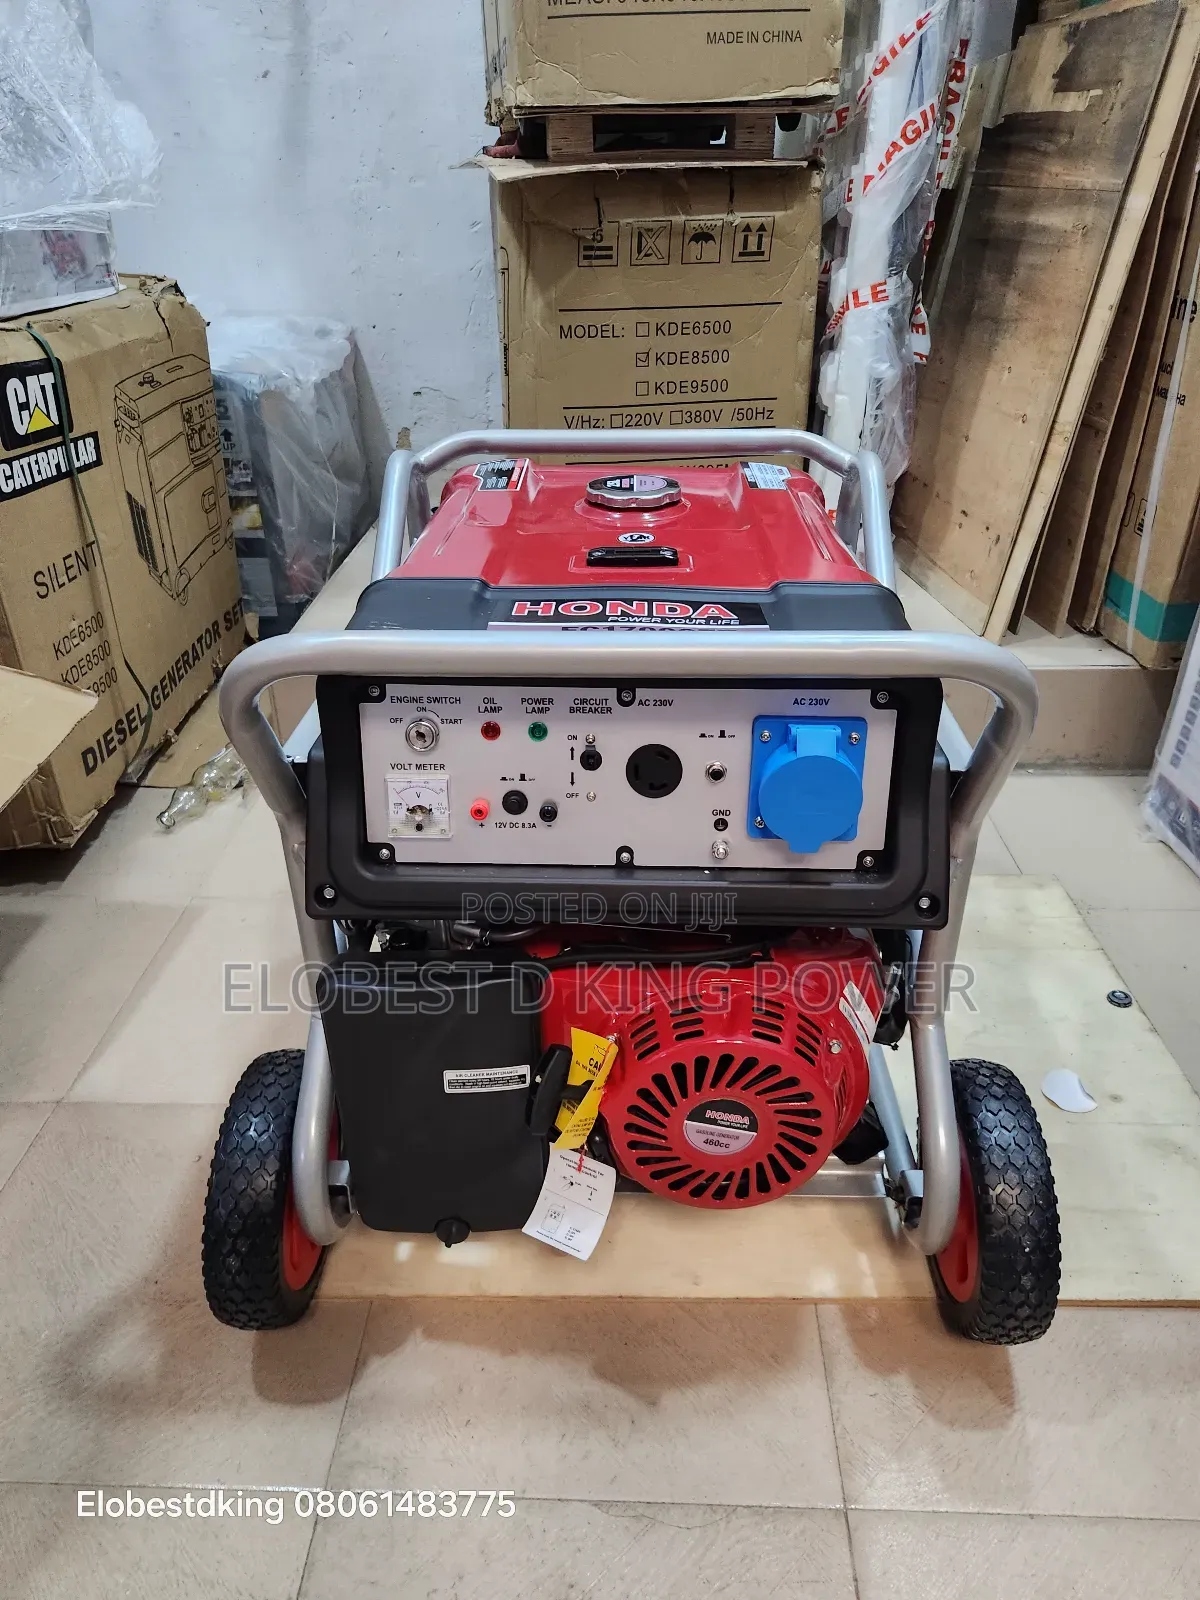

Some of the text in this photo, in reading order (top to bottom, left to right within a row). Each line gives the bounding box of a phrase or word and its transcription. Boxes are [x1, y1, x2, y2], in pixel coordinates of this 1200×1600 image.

[706, 30, 803, 45] MADE IN CHINA
[559, 320, 732, 340] MODEL: KDE6500
[655, 350, 730, 366] KDE8500
[654, 379, 729, 395] KDE9500
[6, 372, 59, 436] CAT
[564, 407, 774, 429] V/Hz: 220V 380V /50Hz
[222, 443, 236, 451] UP
[33, 541, 100, 600] SILENT
[511, 600, 738, 618] HONDA
[53, 611, 104, 660] KDE6500
[61, 640, 110, 685] KDE8500
[81, 598, 244, 777] DIESEL GENERATOR SET
[390, 696, 461, 705] ENGINE SWITCH
[482, 697, 498, 705] OIL
[521, 698, 554, 706] POWER
[573, 698, 609, 706] CIRCUIT
[637, 699, 674, 707] AC 230V
[793, 698, 830, 706] AC 230V
[478, 706, 503, 714] LAMP
[525, 707, 551, 715] LAMP
[569, 707, 613, 715] BREAKER
[567, 734, 578, 742] ON
[390, 763, 446, 772] VOLT METER
[705, 1110, 750, 1124] HONDA
[703, 1138, 731, 1149] 460cc
